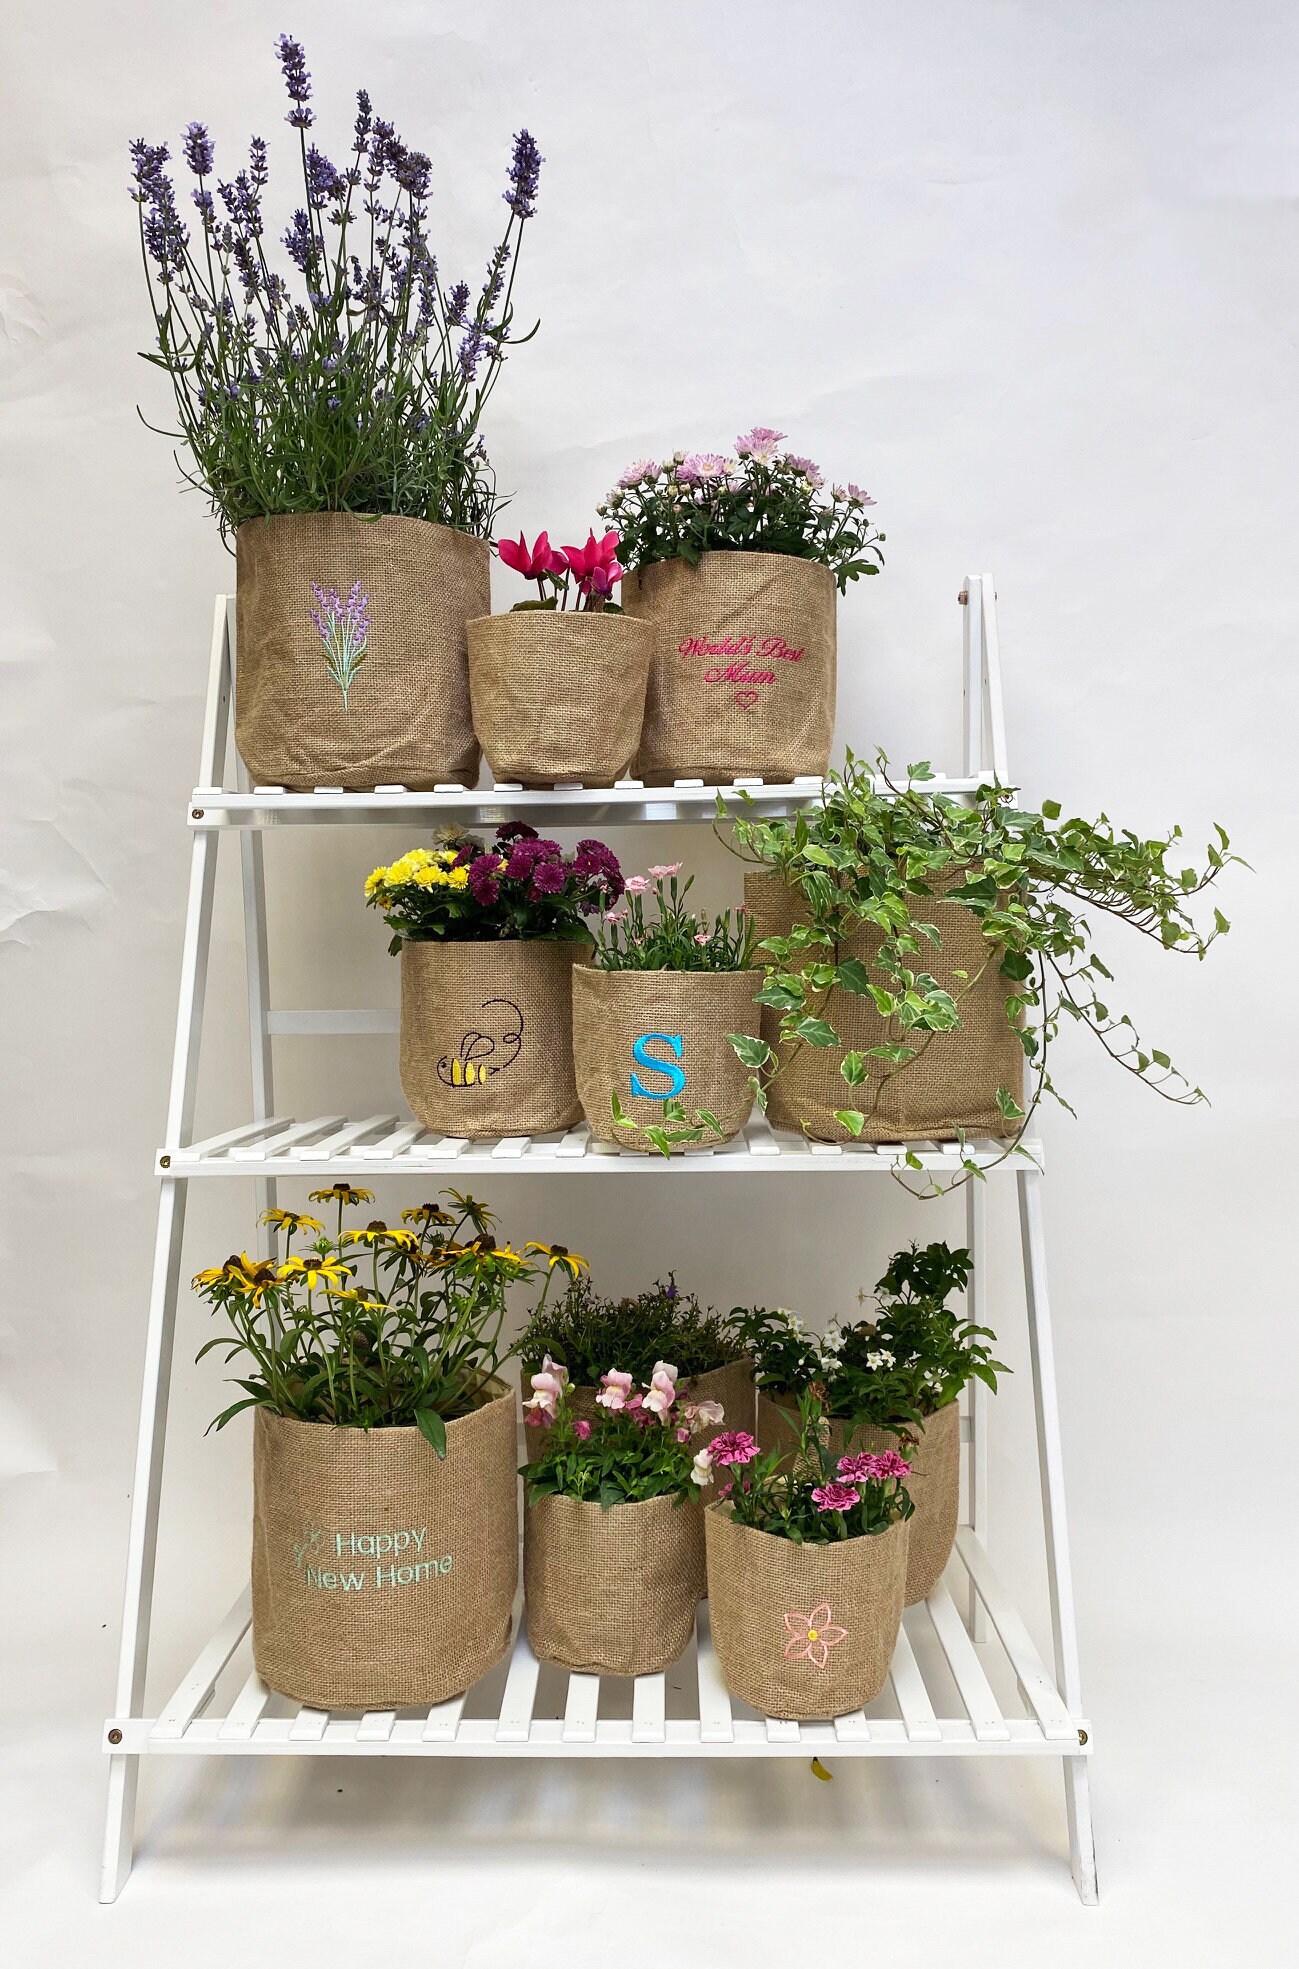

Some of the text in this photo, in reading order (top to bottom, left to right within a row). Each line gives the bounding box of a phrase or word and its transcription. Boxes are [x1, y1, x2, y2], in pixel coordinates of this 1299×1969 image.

[679, 633, 805, 662] World's Best
[704, 661, 776, 684] Mum
[630, 1032, 687, 1100] S
[335, 1526, 427, 1559] Happy
[306, 1554, 453, 1592] New Home
